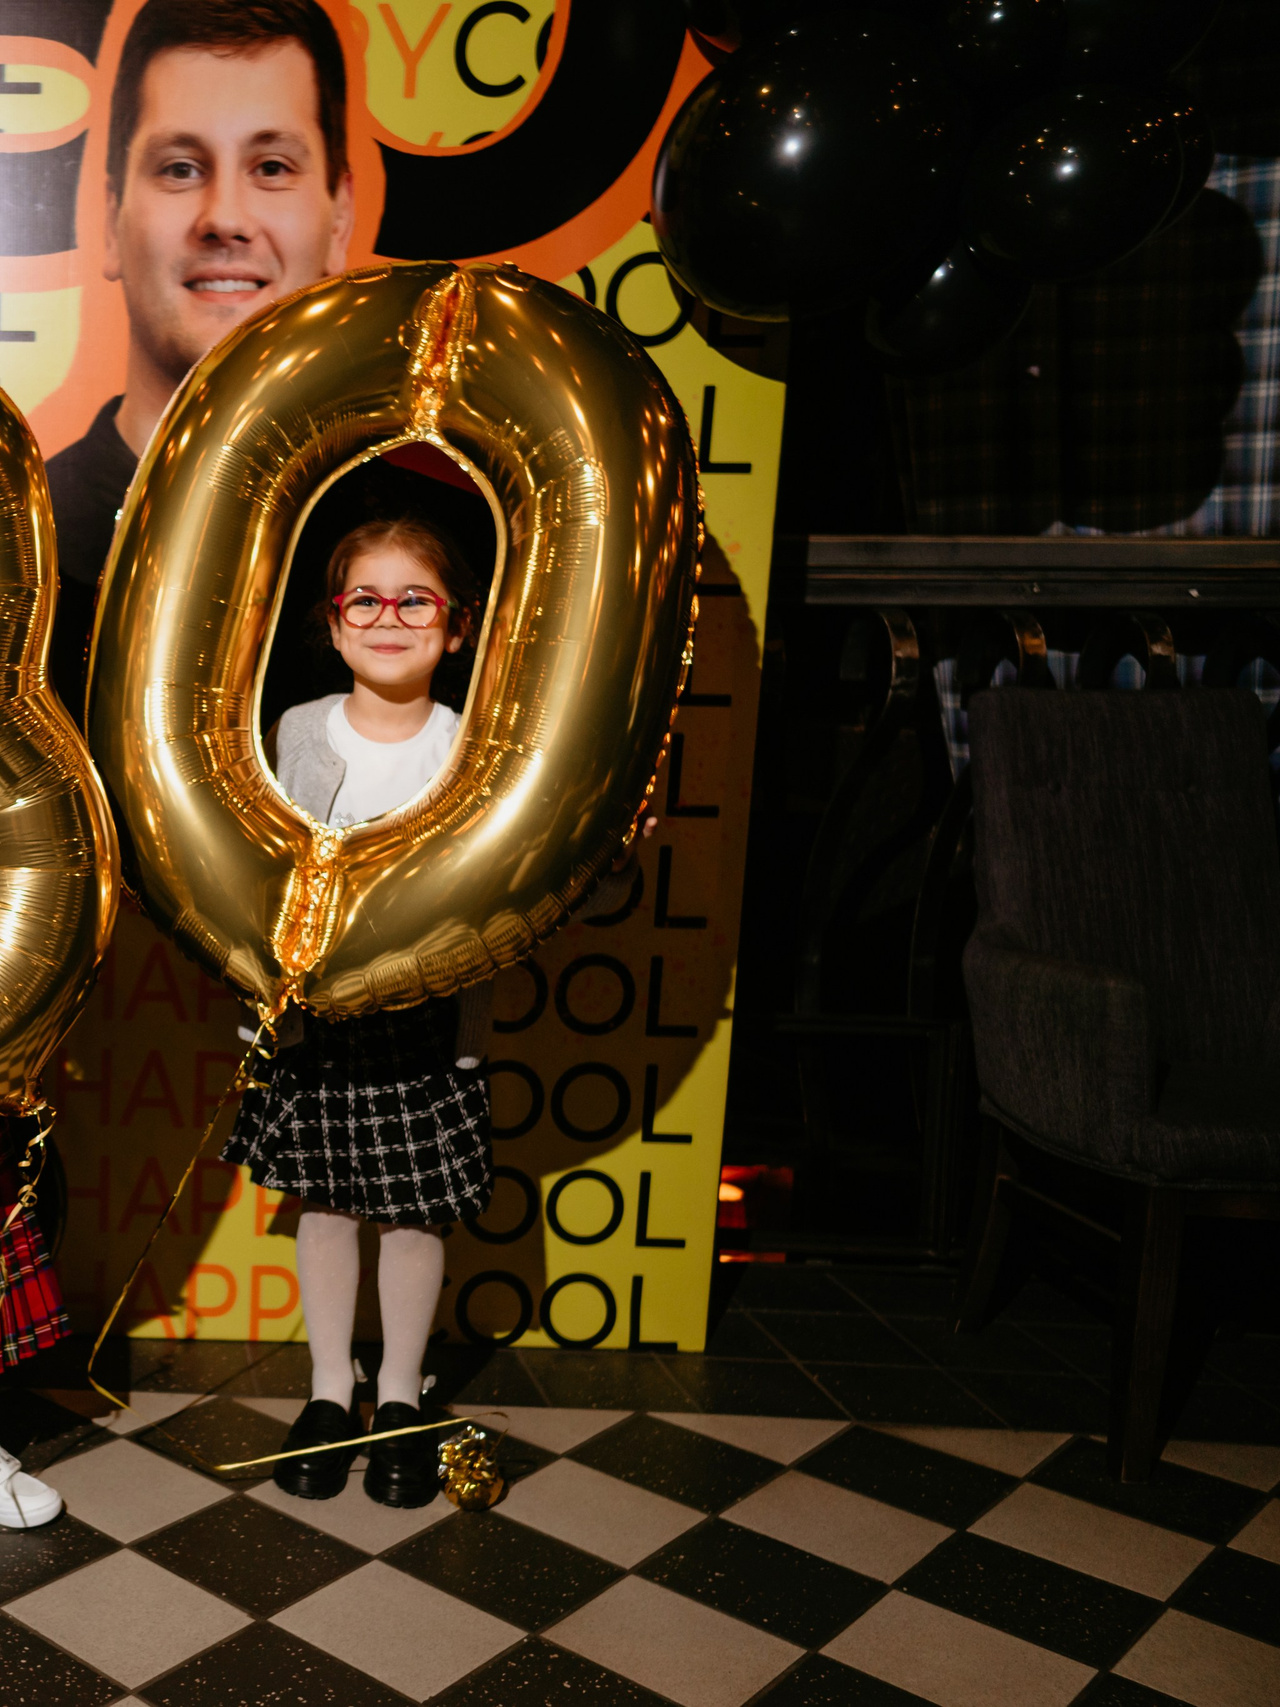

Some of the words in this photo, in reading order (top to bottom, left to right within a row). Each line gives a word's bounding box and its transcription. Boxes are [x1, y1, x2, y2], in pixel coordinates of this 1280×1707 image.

[486, 1059, 692, 1143] OOL
[441, 1165, 686, 1249] OOL
[55, 1260, 301, 1341] HAPP
[429, 1268, 677, 1350] OOL
